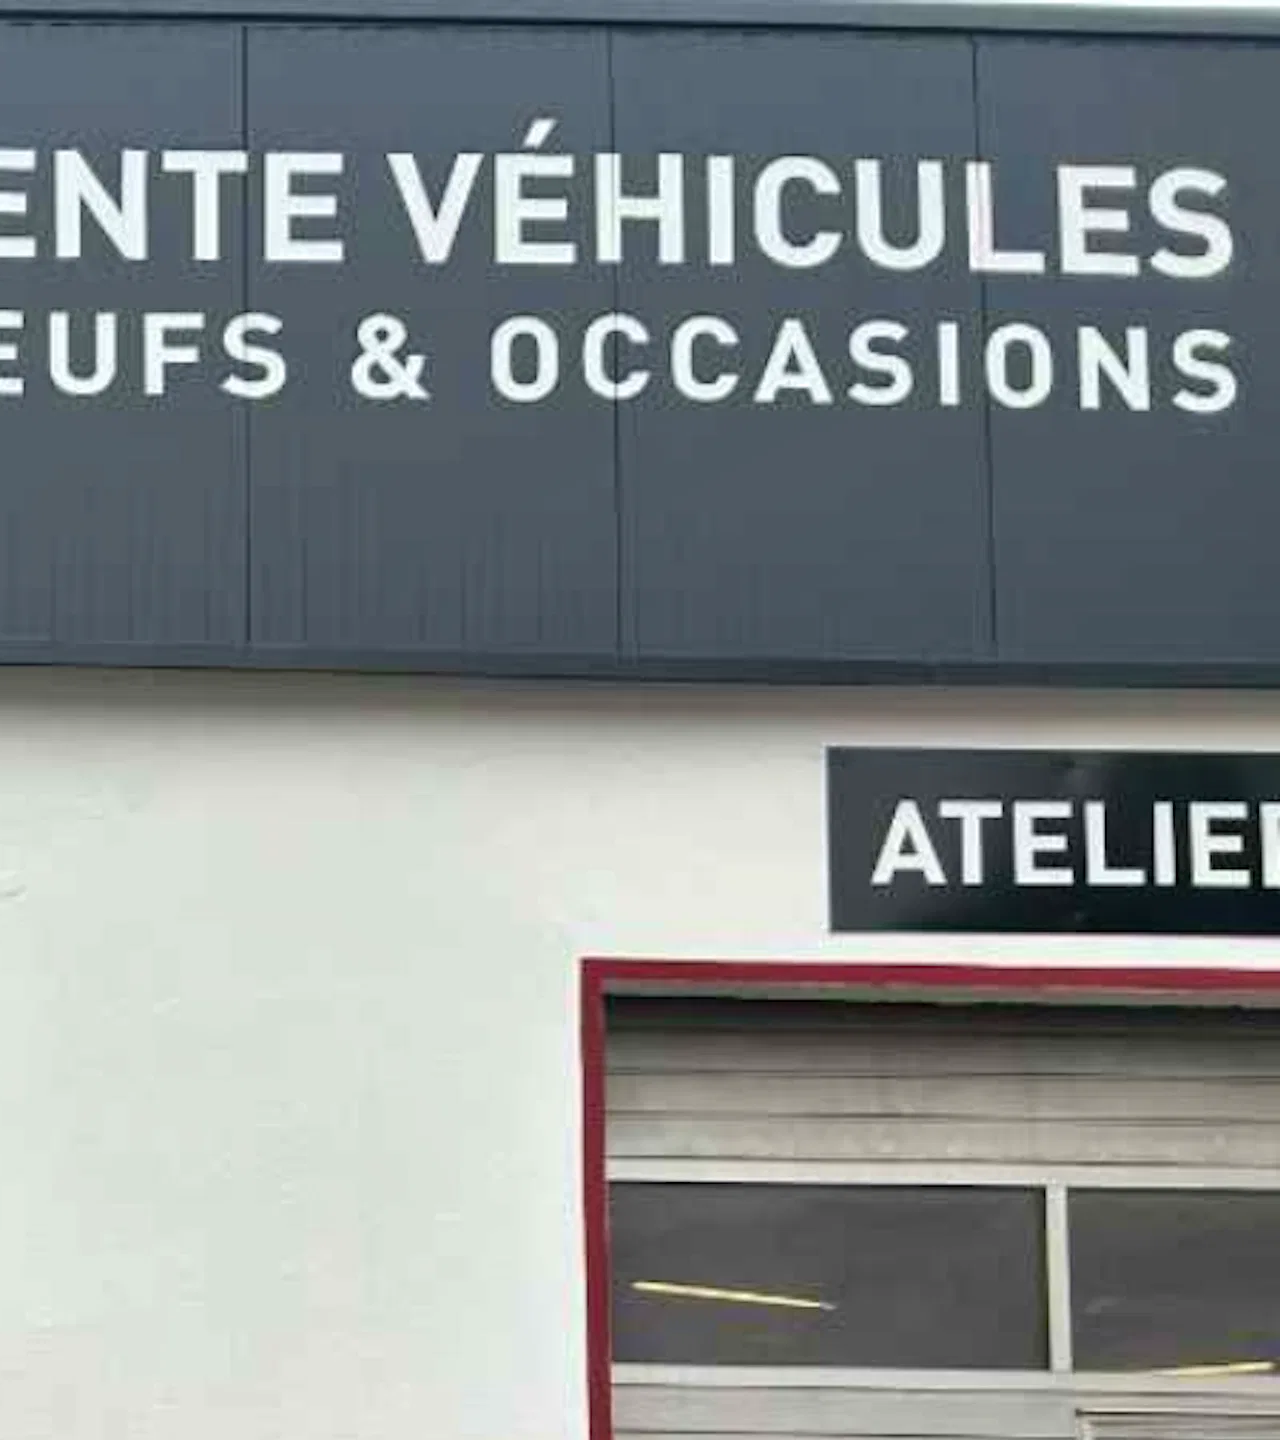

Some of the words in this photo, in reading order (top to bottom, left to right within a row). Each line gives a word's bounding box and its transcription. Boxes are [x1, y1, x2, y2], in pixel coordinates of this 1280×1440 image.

[385, 118, 1236, 279] VÉHICULES
[351, 313, 430, 400] &
[490, 313, 1239, 413] OCCASIONS
